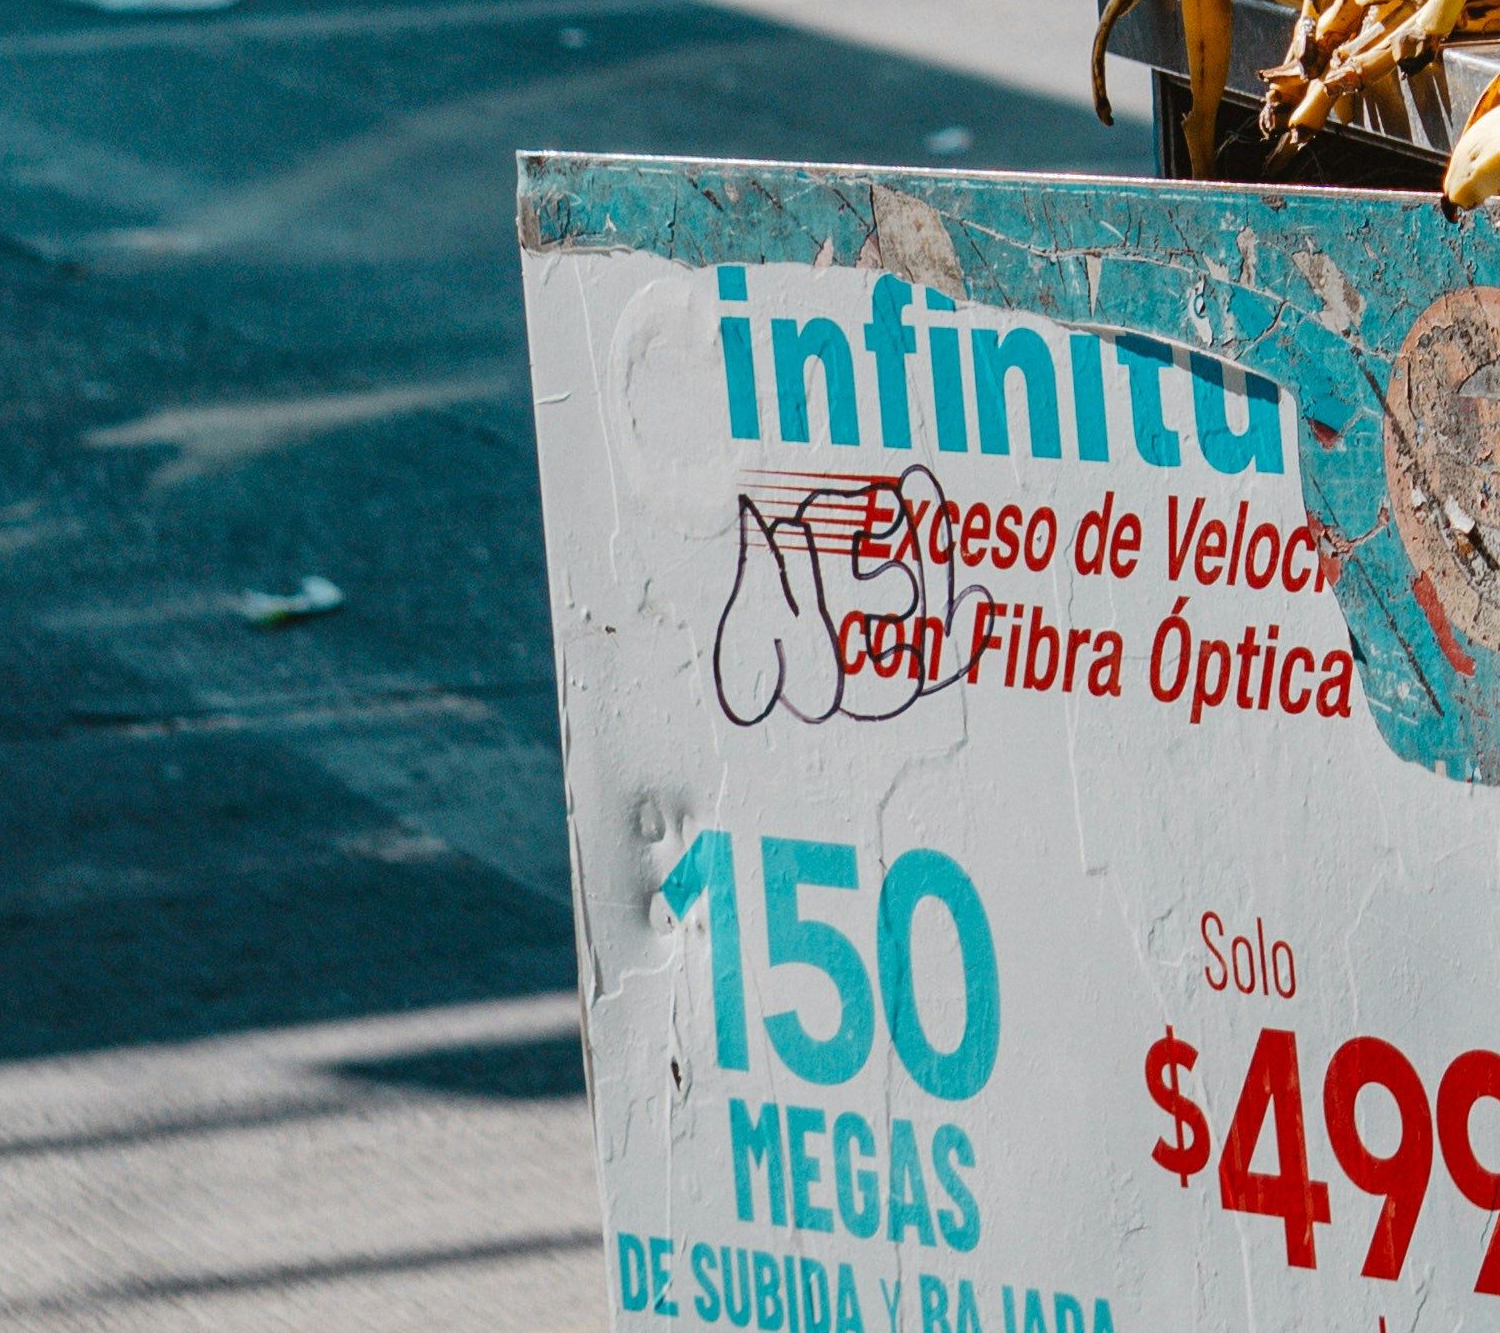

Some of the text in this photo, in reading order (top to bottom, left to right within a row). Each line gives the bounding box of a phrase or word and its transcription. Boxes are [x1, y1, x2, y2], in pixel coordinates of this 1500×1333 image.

[717, 264, 1285, 474] infinitu
[855, 475, 1057, 572] Exceso
[1073, 491, 1142, 579] de
[838, 596, 1354, 725] con Fibra Óptica
[659, 829, 1002, 1101] 150
[1200, 910, 1297, 1000] Solo
[728, 1096, 981, 1253] MEGAS
[617, 1231, 679, 1318] DE
[690, 1241, 865, 1333] SUBIDA
[879, 1278, 901, 1333] Y
